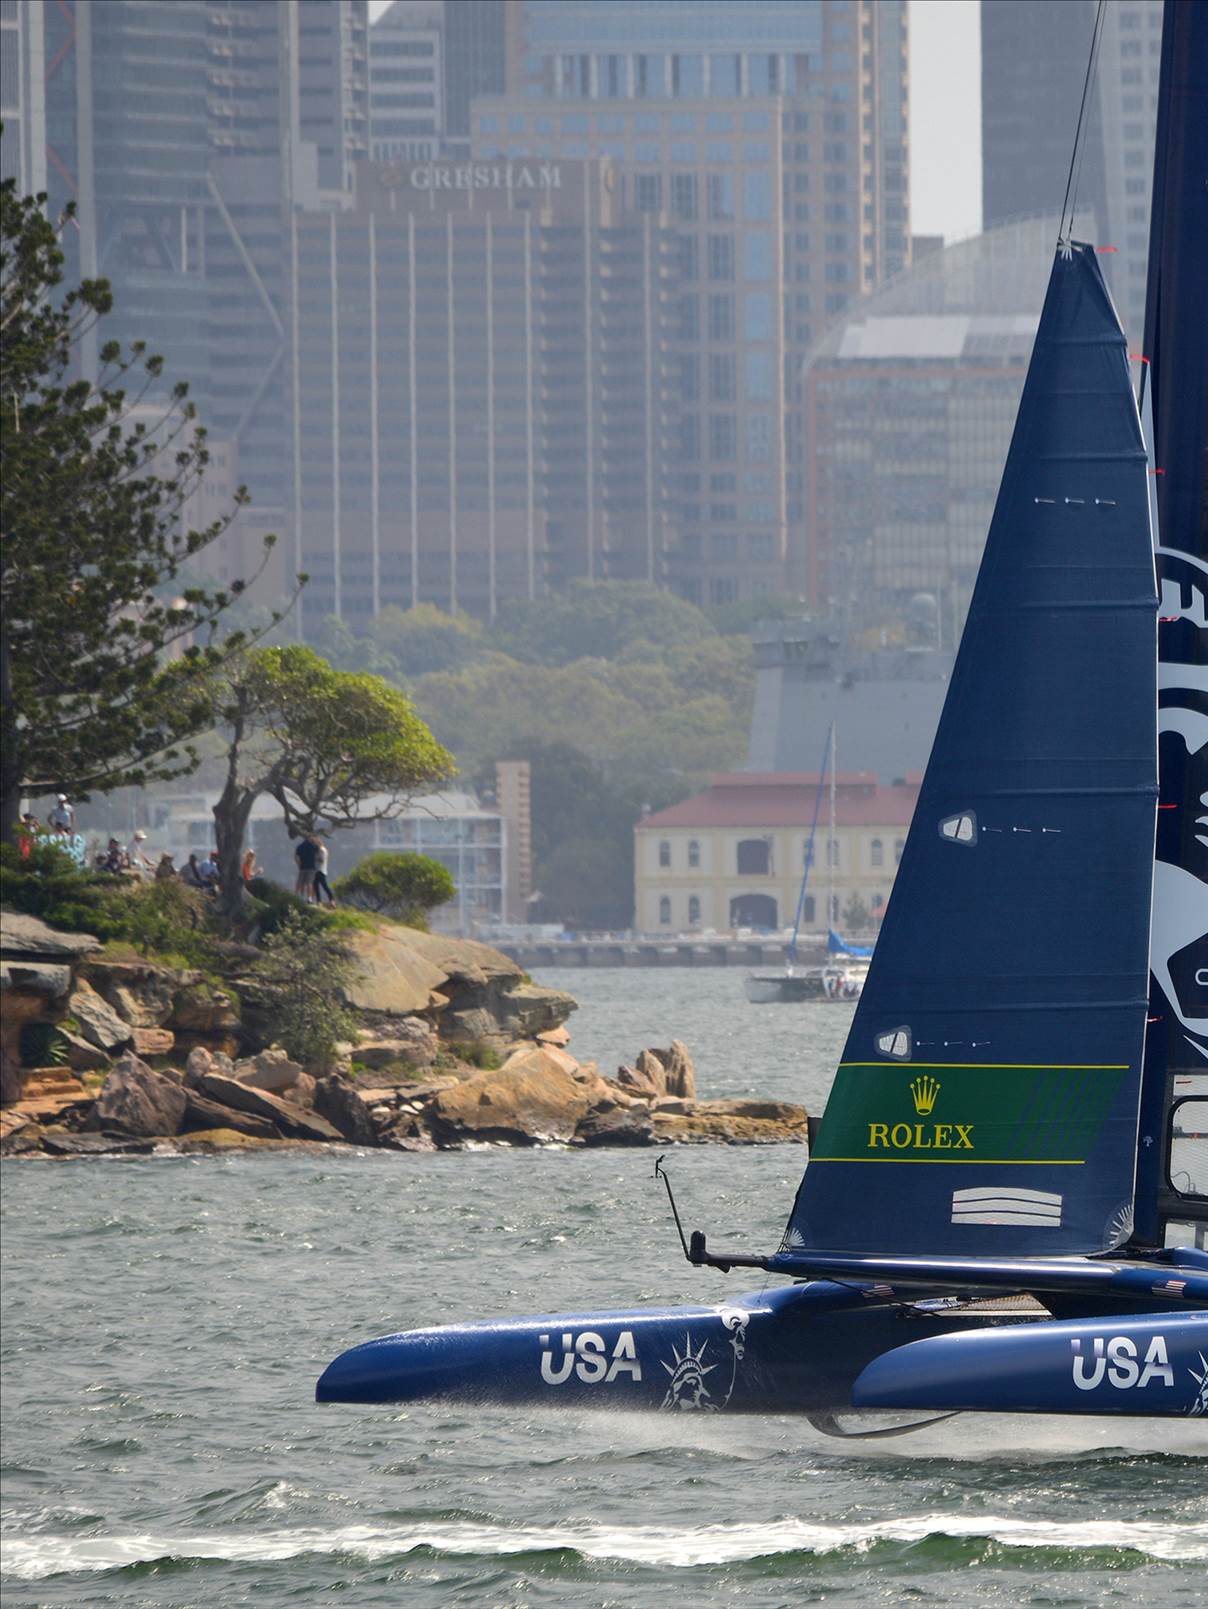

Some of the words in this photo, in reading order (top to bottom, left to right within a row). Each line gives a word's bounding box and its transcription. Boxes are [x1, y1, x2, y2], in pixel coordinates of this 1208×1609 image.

[410, 165, 561, 190] GRESHAM
[867, 1123, 975, 1149] ROLEX
[539, 1331, 642, 1385] USA
[1071, 1336, 1174, 1390] USA
